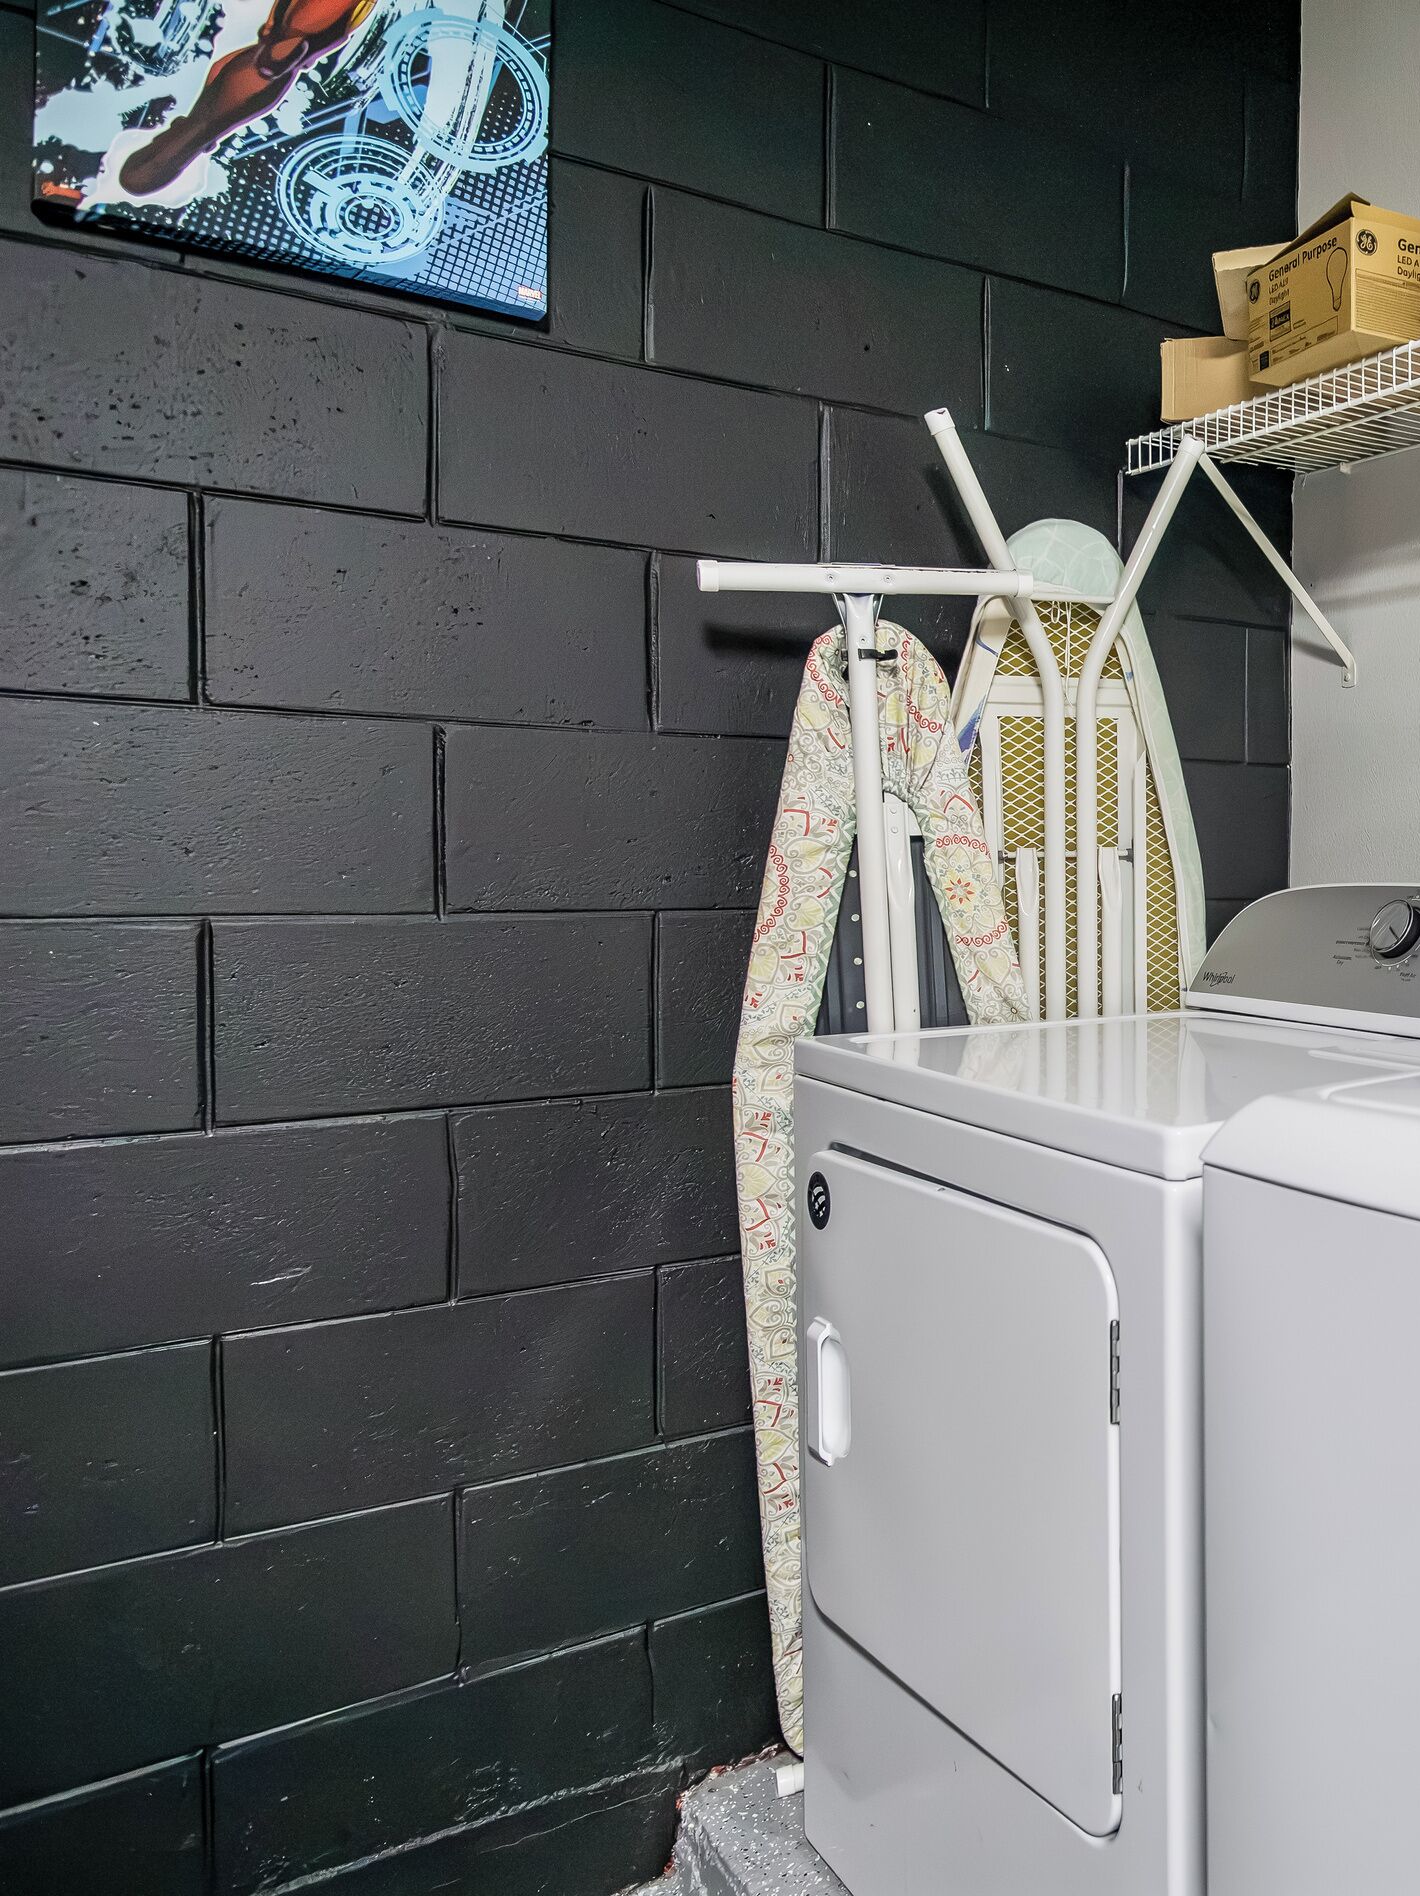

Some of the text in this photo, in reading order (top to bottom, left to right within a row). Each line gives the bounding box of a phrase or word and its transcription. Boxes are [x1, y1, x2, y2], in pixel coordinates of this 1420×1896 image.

[1268, 236, 1338, 282] General Purpose
[1397, 254, 1413, 266] LED
[1203, 971, 1237, 988] Whirlpool
